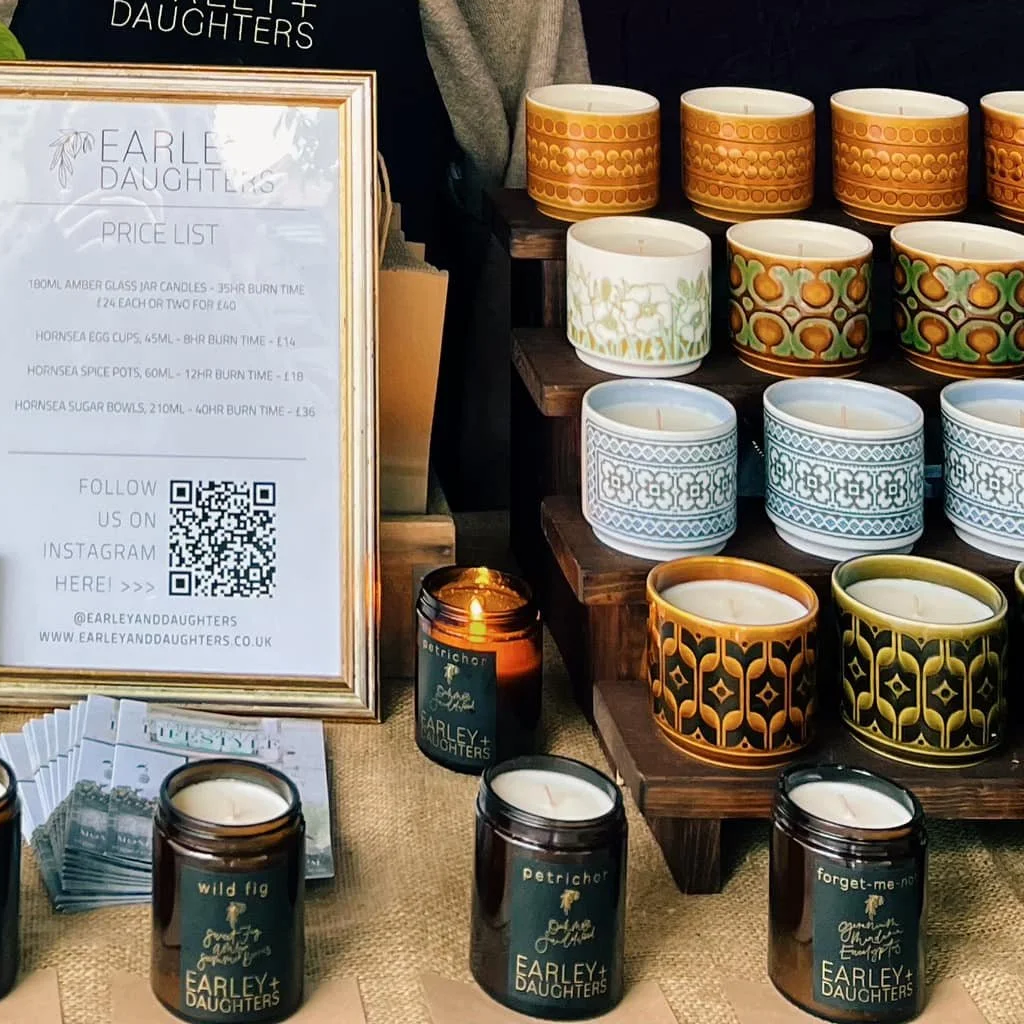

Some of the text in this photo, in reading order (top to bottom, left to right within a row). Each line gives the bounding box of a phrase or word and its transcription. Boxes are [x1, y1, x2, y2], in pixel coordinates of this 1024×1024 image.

[111, 0, 314, 49] DAUGHTERS
[102, 221, 219, 245] PRICE LIST
[28, 279, 62, 290] 180ML
[64, 279, 102, 291] AMBER
[105, 280, 137, 292] GLASS
[139, 281, 157, 293] JAR
[159, 281, 207, 293] CANDLES
[217, 282, 246, 295] 35HR
[248, 283, 278, 295] BURN
[280, 284, 305, 296] TIME
[118, 297, 146, 309] EACH
[148, 298, 164, 310] OR
[166, 298, 191, 310] TWO
[193, 299, 214, 311] FOR
[217, 300, 237, 312] £40
[35, 330, 86, 342] HORNSEA
[88, 331, 110, 343] EGG
[112, 332, 142, 344] CUPS,
[144, 333, 174, 344] 45ML
[183, 334, 205, 345] 8HR
[208, 334, 238, 345] BURN
[241, 335, 266, 346] TIME
[277, 336, 296, 347] £14
[27, 365, 78, 377] HORNSEA
[80, 366, 110, 377] SPICE
[112, 367, 142, 379] POTS,
[145, 368, 175, 379] 60ML
[185, 369, 213, 380] 12HR
[215, 370, 245, 380] BURN
[247, 370, 273, 381] TIME
[15, 400, 66, 412] HORNSEA
[68, 401, 104, 413] SUGAR
[106, 402, 146, 414] BOWLS,
[150, 403, 185, 415] 210ML
[195, 404, 224, 415] 40HR
[226, 405, 257, 416] BURN
[259, 405, 284, 417] TIME
[79, 478, 158, 496] FOLLOW
[98, 511, 157, 528] US ON
[43, 542, 157, 561] INSTAGRAM
[55, 575, 112, 593] HERE!
[73, 611, 238, 627] @EARLEYANDDAUGHTERS
[39, 631, 273, 647] WWW.EARLEYANDDAUGHTERS.CO.UK
[817, 867, 918, 892] forget-me-no
[198, 881, 269, 898] wild fig
[515, 976, 608, 999] DAUGHTERS
[821, 980, 913, 1003] DAUGHTERS
[186, 990, 280, 1014] DAUGHTERS
